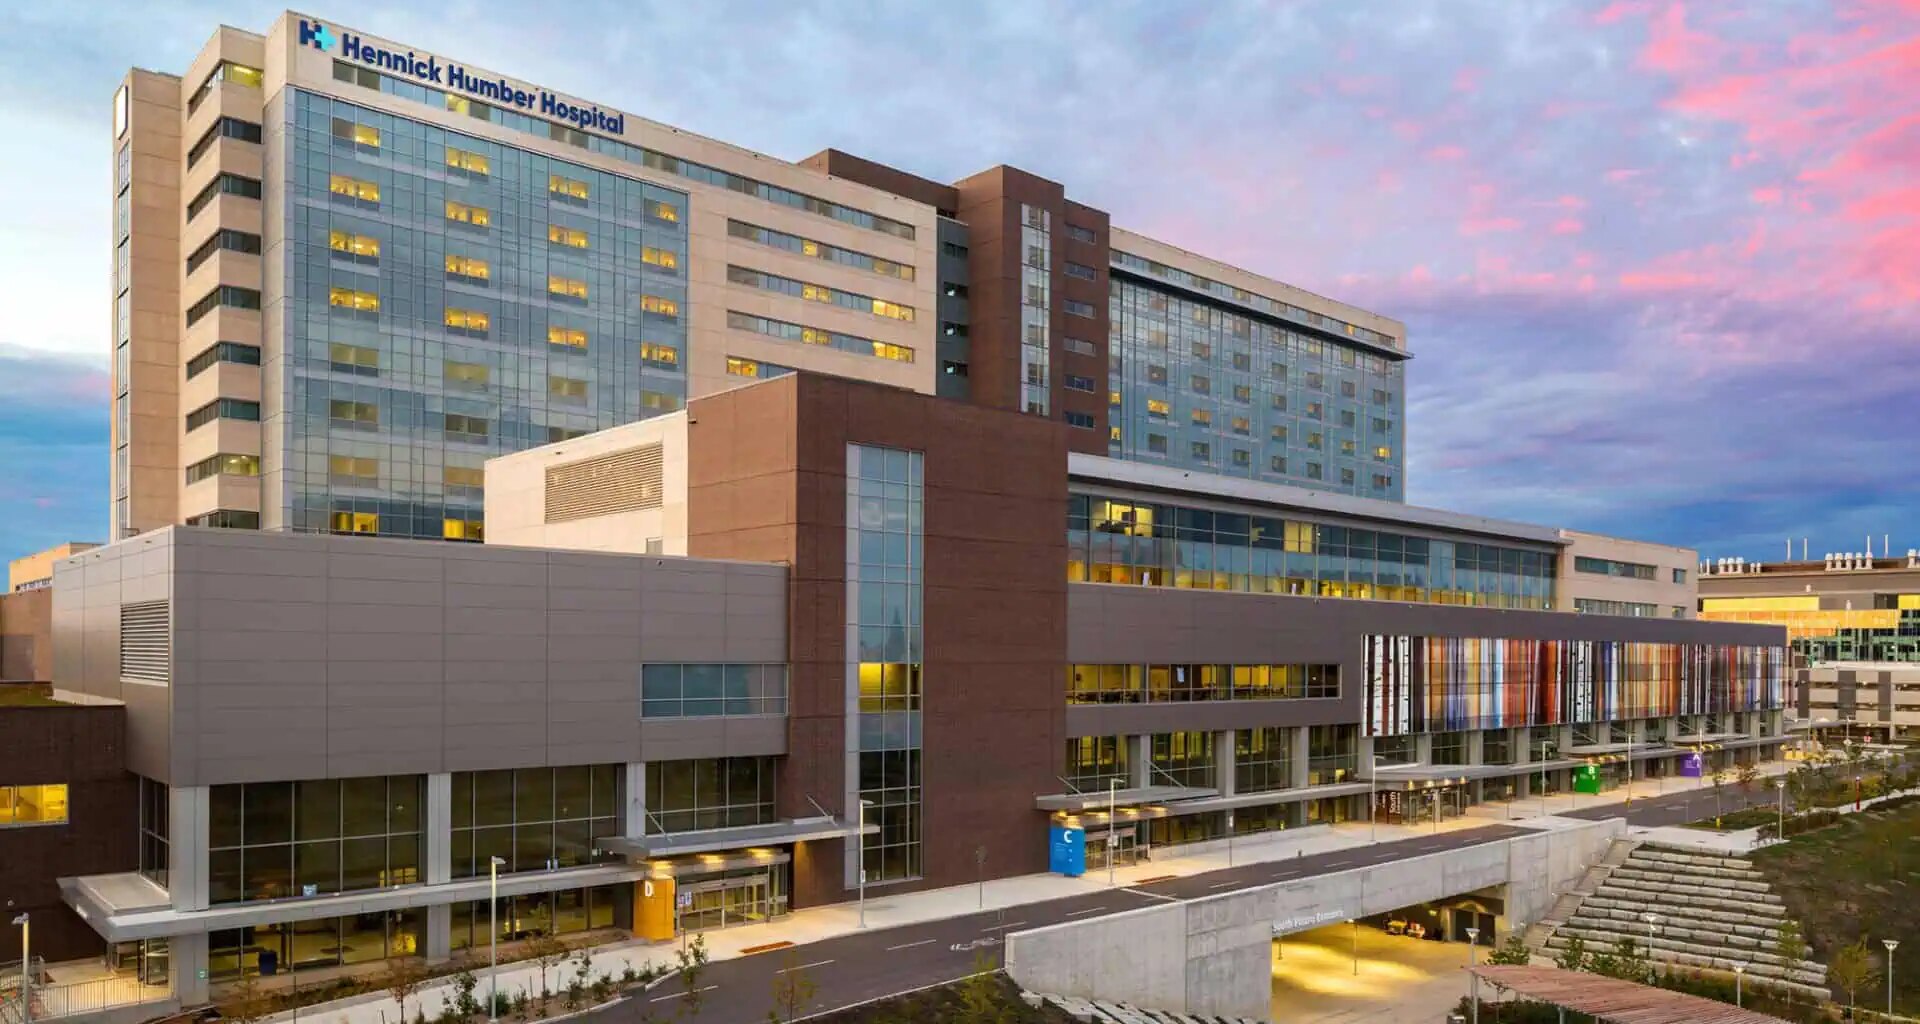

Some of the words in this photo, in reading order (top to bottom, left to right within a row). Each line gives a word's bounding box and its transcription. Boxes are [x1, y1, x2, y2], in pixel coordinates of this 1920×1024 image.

[342, 32, 442, 84] Hennick
[447, 64, 537, 109] Humber
[540, 92, 625, 136] Hospital
[1063, 829, 1073, 844] C
[644, 880, 655, 897] D
